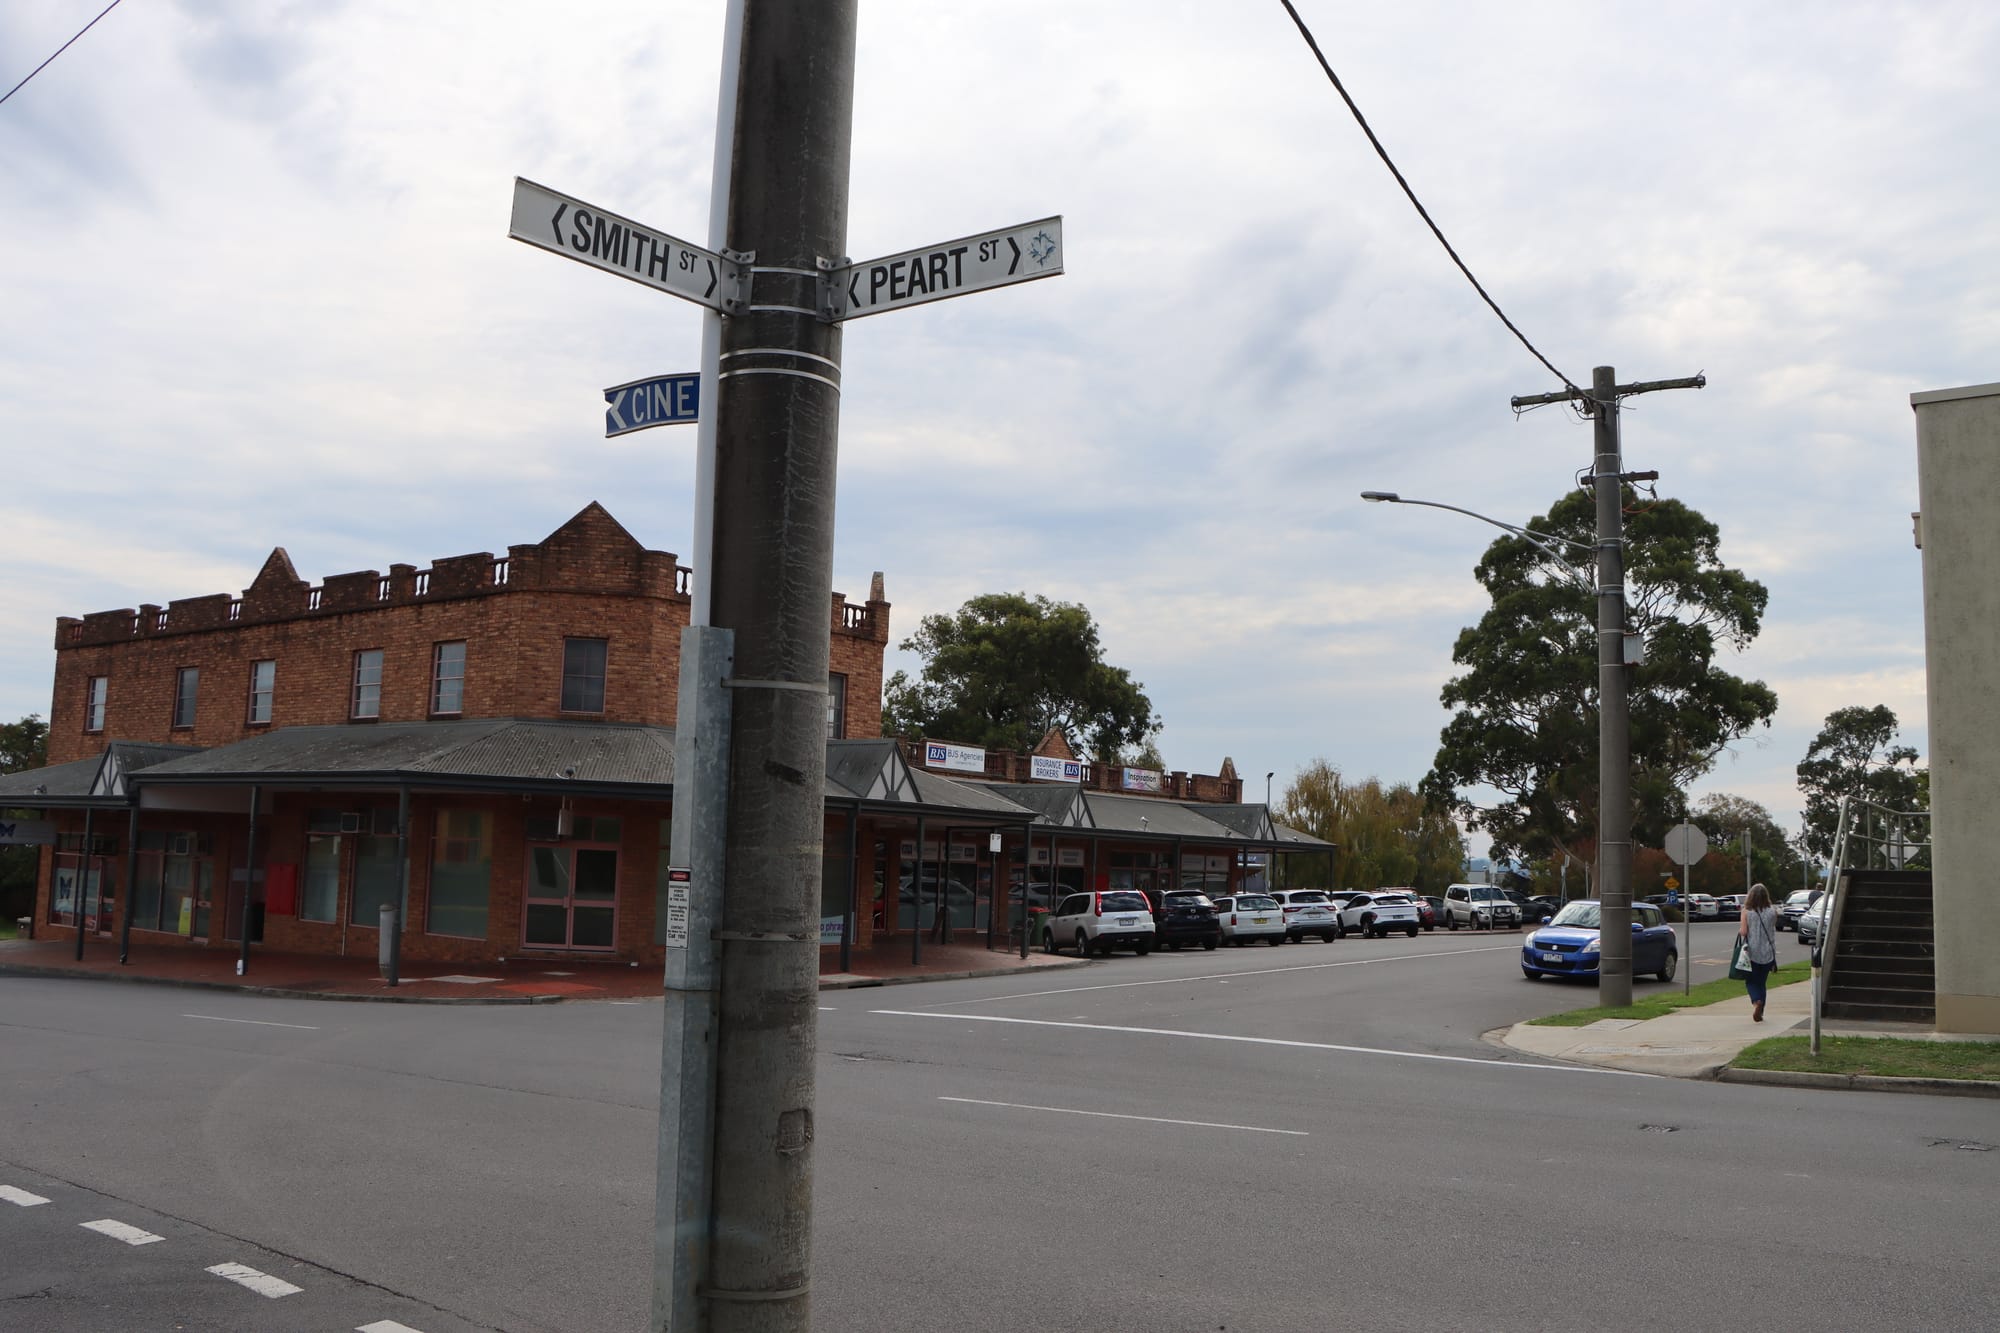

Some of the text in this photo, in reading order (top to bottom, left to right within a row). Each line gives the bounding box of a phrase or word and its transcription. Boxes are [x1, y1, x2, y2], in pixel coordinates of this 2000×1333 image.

[571, 209, 698, 283] SMITH ST
[870, 239, 999, 305] PEART ST
[929, 747, 946, 760] BJS
[947, 749, 983, 761] BJS Agencies
[1034, 758, 1062, 770] INSURANCE
[1065, 764, 1079, 776] BJS
[1036, 767, 1059, 778] BROKERS
[1127, 771, 1157, 783] Inspiration
